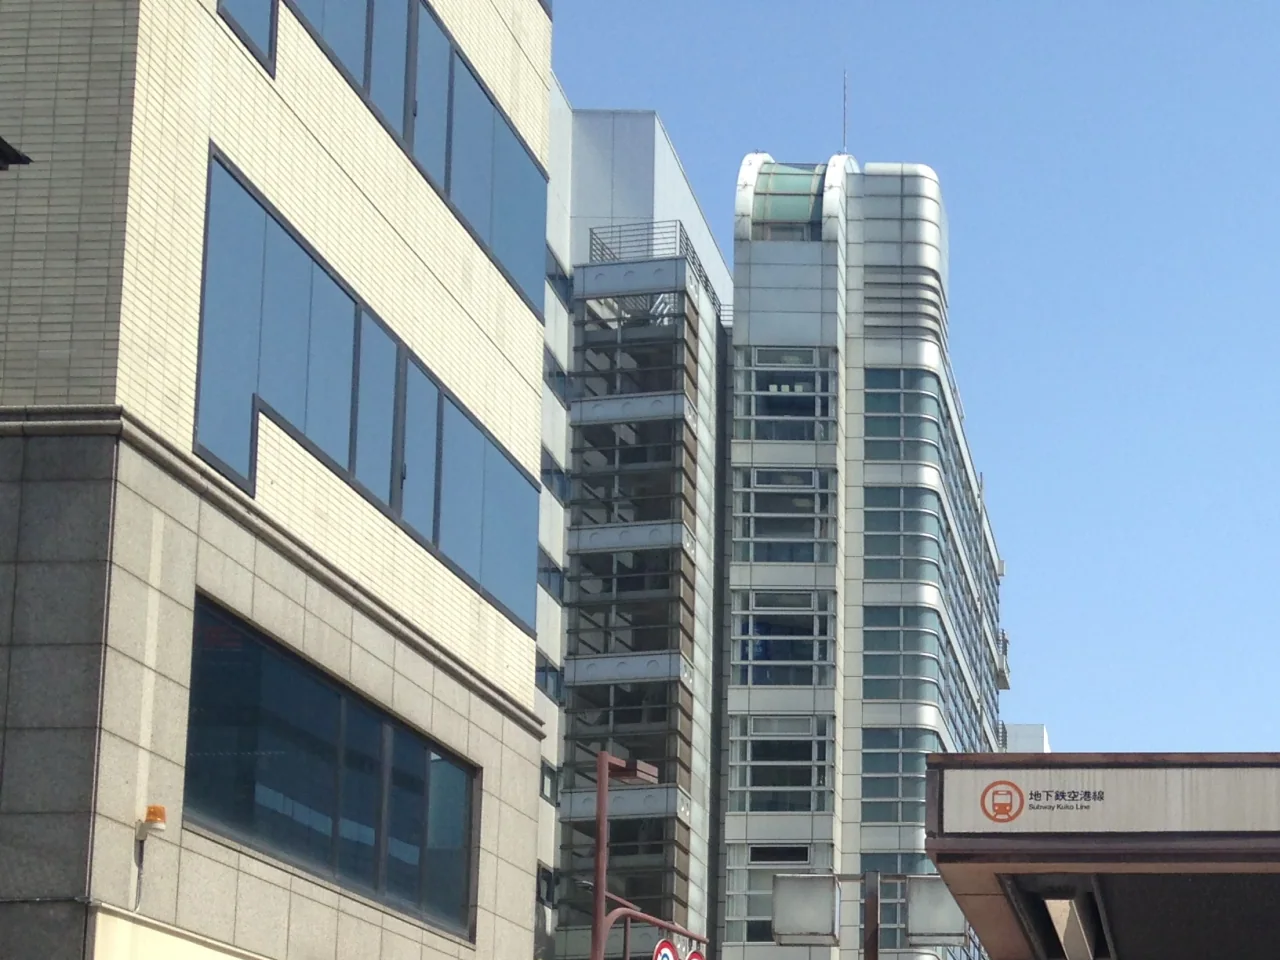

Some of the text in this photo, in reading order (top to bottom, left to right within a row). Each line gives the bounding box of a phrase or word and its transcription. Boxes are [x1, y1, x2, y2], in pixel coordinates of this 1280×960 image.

[1028, 790, 1105, 801] 地下鉄空港線
[1028, 803, 1055, 811] Subway
